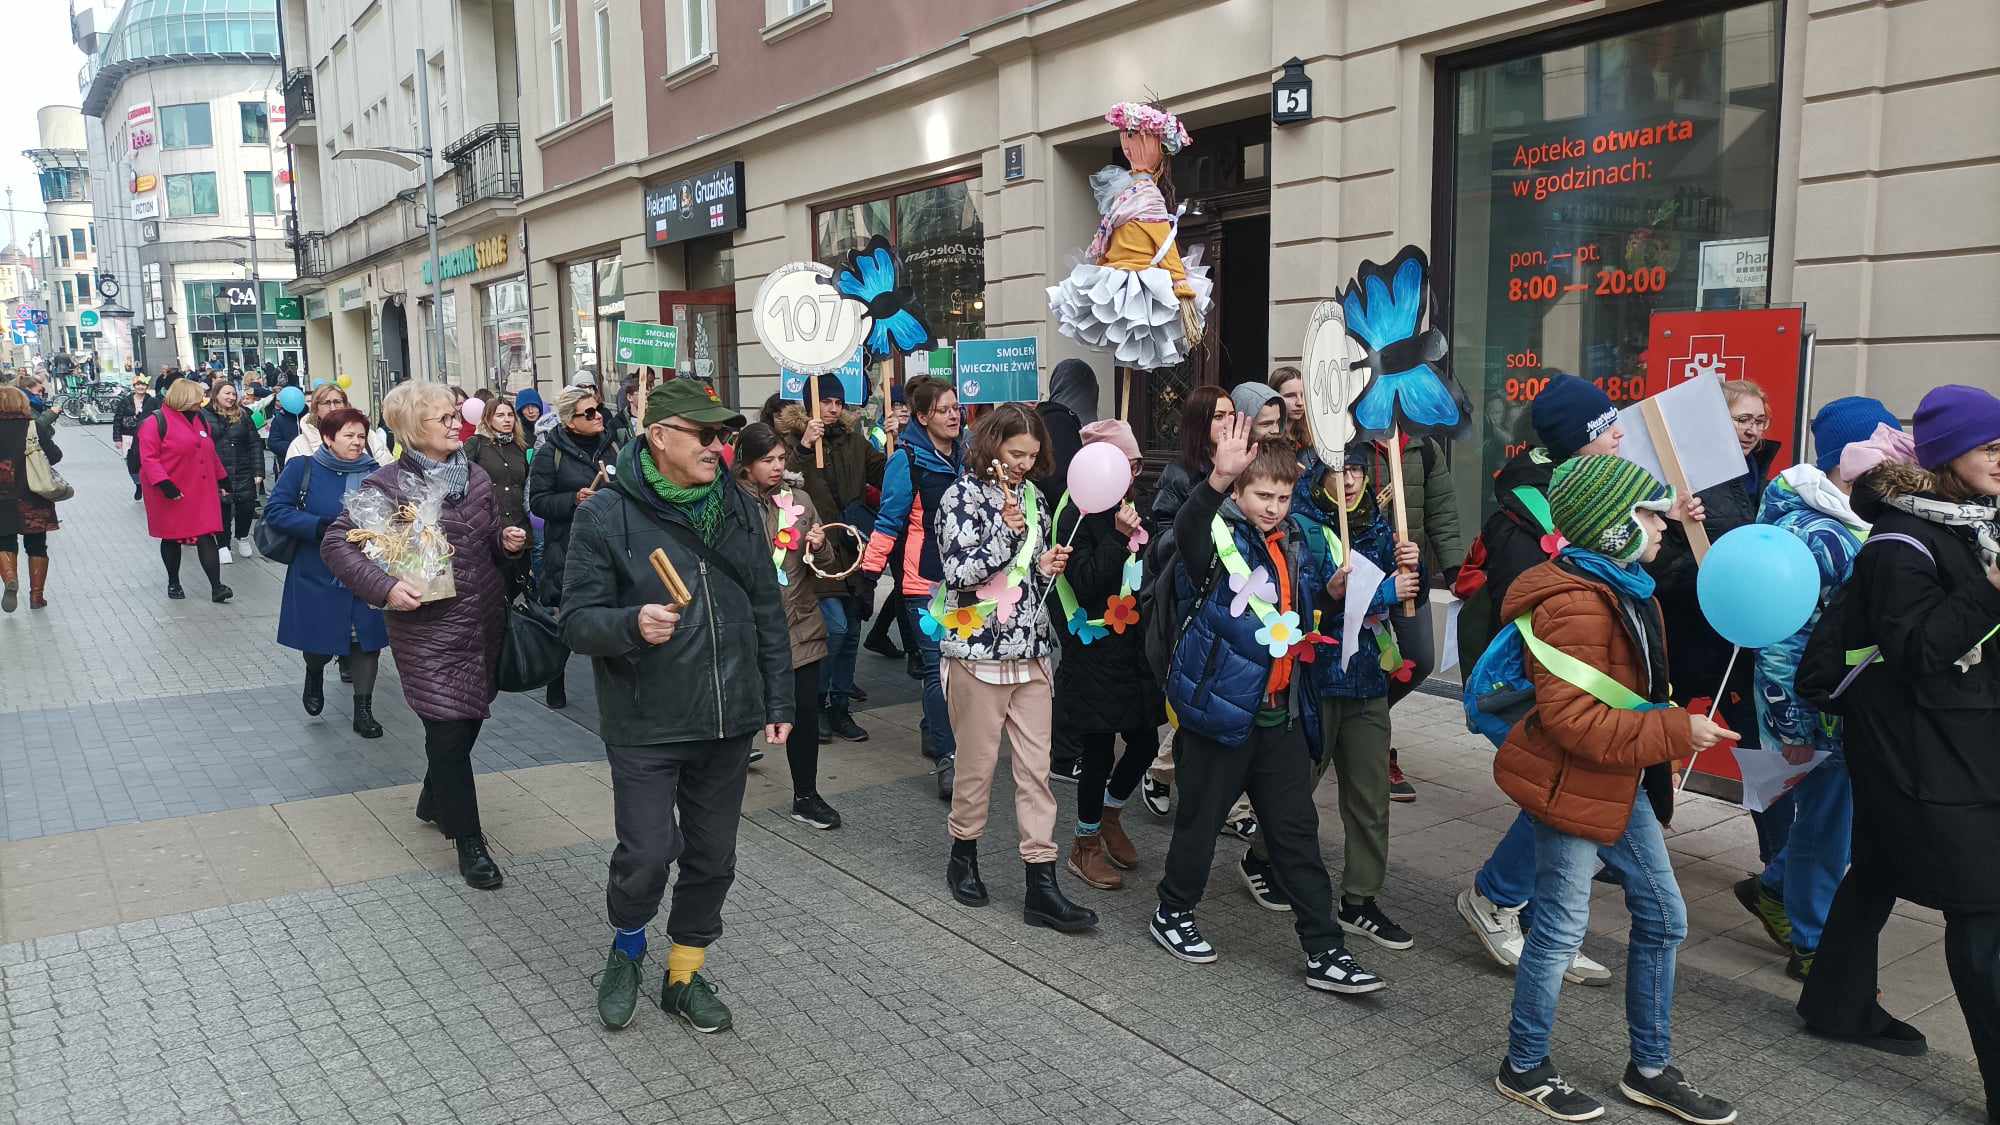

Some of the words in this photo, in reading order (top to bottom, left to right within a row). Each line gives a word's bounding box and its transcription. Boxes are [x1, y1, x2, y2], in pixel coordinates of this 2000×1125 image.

[1286, 88, 1299, 112] 5
[1011, 151, 1017, 163] 5
[1513, 136, 1585, 169] Apteka
[1592, 119, 1693, 154] otwarta
[1513, 180, 1530, 196] w
[1535, 157, 1653, 200] godzinach:
[646, 187, 677, 217] Piekarnia
[695, 170, 735, 204] Gruzińska
[1509, 250, 1547, 272] pon.
[1576, 243, 1600, 268] pt.
[1508, 275, 1557, 301] 8:00
[1595, 266, 1667, 296] 20:00
[768, 295, 843, 342] 107
[996, 344, 1035, 358] SMOLEŃ
[1506, 349, 1541, 368] sob.
[960, 362, 1009, 374] WIECZNIE
[1010, 361, 1036, 372] ŻYWY
